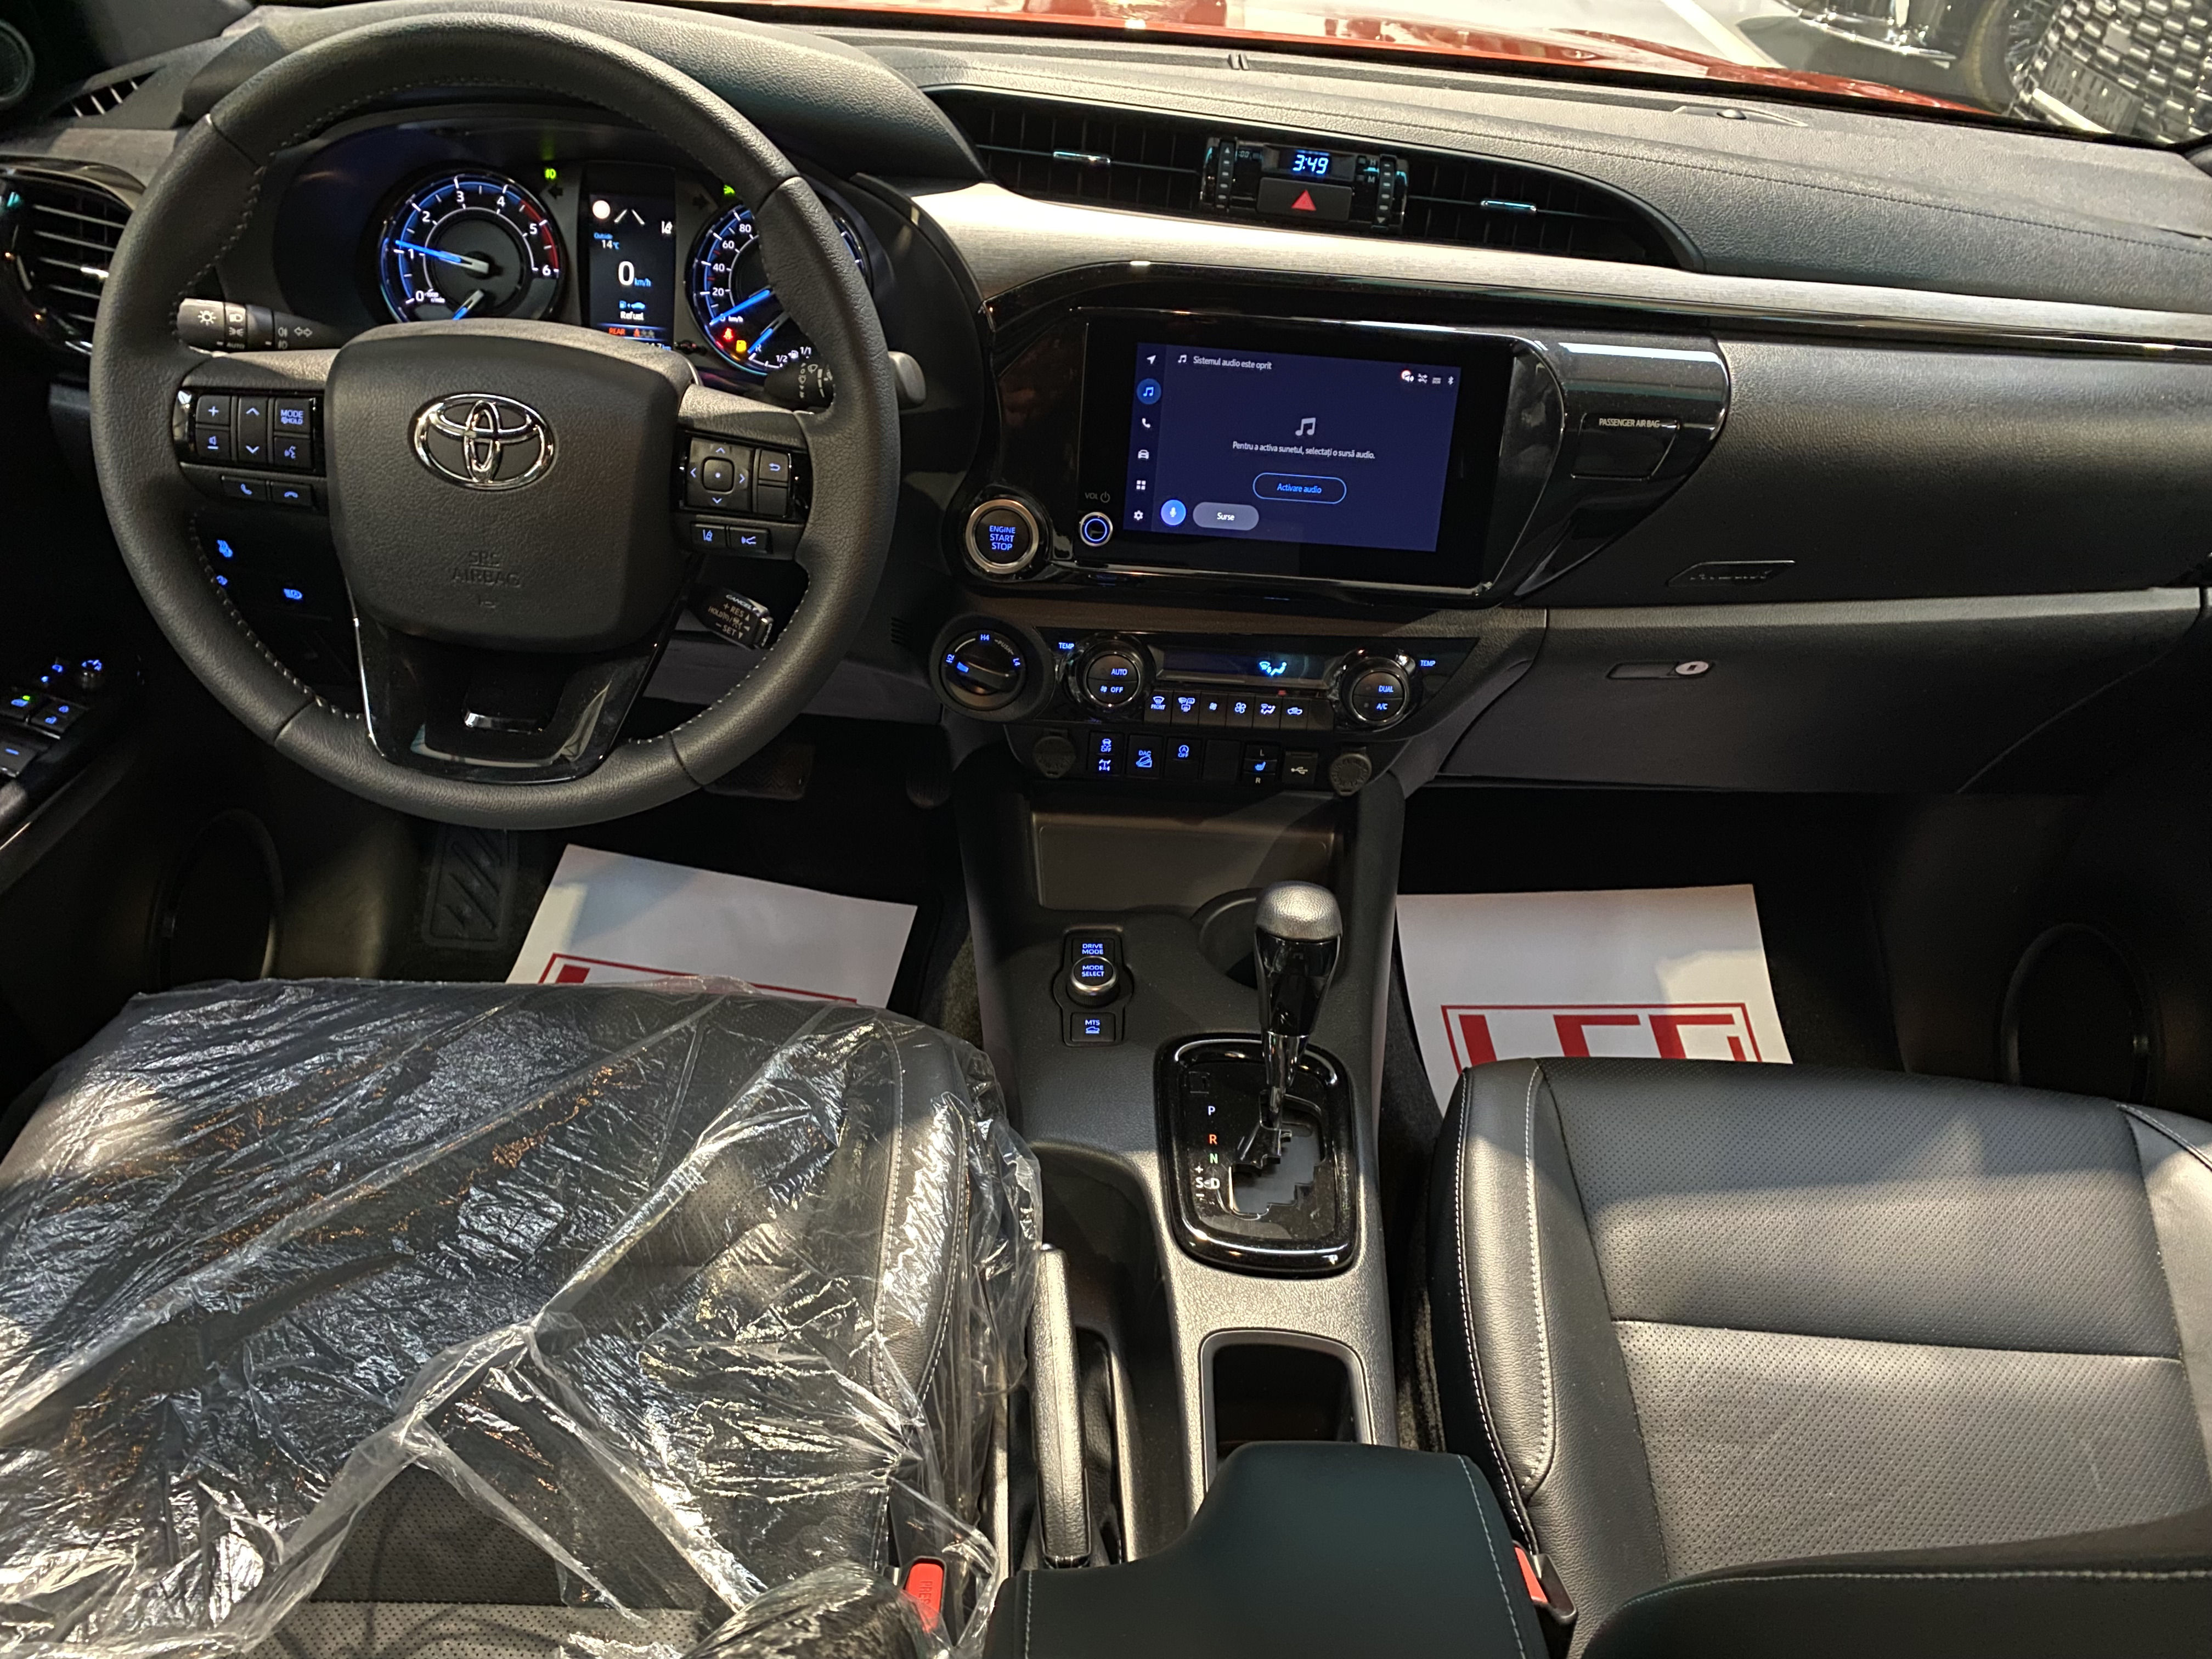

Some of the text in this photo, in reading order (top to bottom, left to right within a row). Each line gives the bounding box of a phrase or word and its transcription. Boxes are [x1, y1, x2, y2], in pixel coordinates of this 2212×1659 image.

[1292, 154, 1329, 174] 3:49
[456, 191, 465, 202] 3
[496, 196, 505, 207] 4
[422, 211, 431, 222] 2
[529, 223, 538, 235] 5
[739, 223, 752, 233] 80
[722, 240, 735, 249] 60
[408, 249, 415, 259] 1
[542, 265, 551, 276] 6
[713, 263, 725, 272] 40
[618, 261, 635, 285] 0
[415, 290, 424, 302] 0
[712, 287, 724, 296] 20
[620, 311, 644, 321] Refuel
[800, 346, 812, 355] 1/1
[776, 354, 788, 363] 1/2
[1193, 356, 1221, 366] Sistemul
[1222, 359, 1240, 367] audio
[1256, 362, 1272, 370] oprit
[280, 409, 303, 418] MODE
[1599, 418, 1635, 427] PASSENGER
[1233, 441, 1253, 450] Pentru
[1260, 444, 1278, 452] activa
[1279, 445, 1304, 455] sunetul,
[1356, 451, 1375, 459] audio.
[1277, 483, 1322, 493] Activare audio
[1217, 512, 1235, 521] Surse
[989, 525, 1015, 534] ENGINE
[990, 534, 1014, 542] START
[991, 542, 1013, 551] STOP
[726, 594, 752, 610] CANCEL
[730, 606, 744, 617] RES
[723, 624, 737, 636] SET
[946, 654, 955, 663] H2
[1013, 658, 1021, 666] L4
[1208, 1105, 1216, 1116] P
[1209, 1134, 1217, 1144] R
[1210, 1153, 1218, 1164] N
